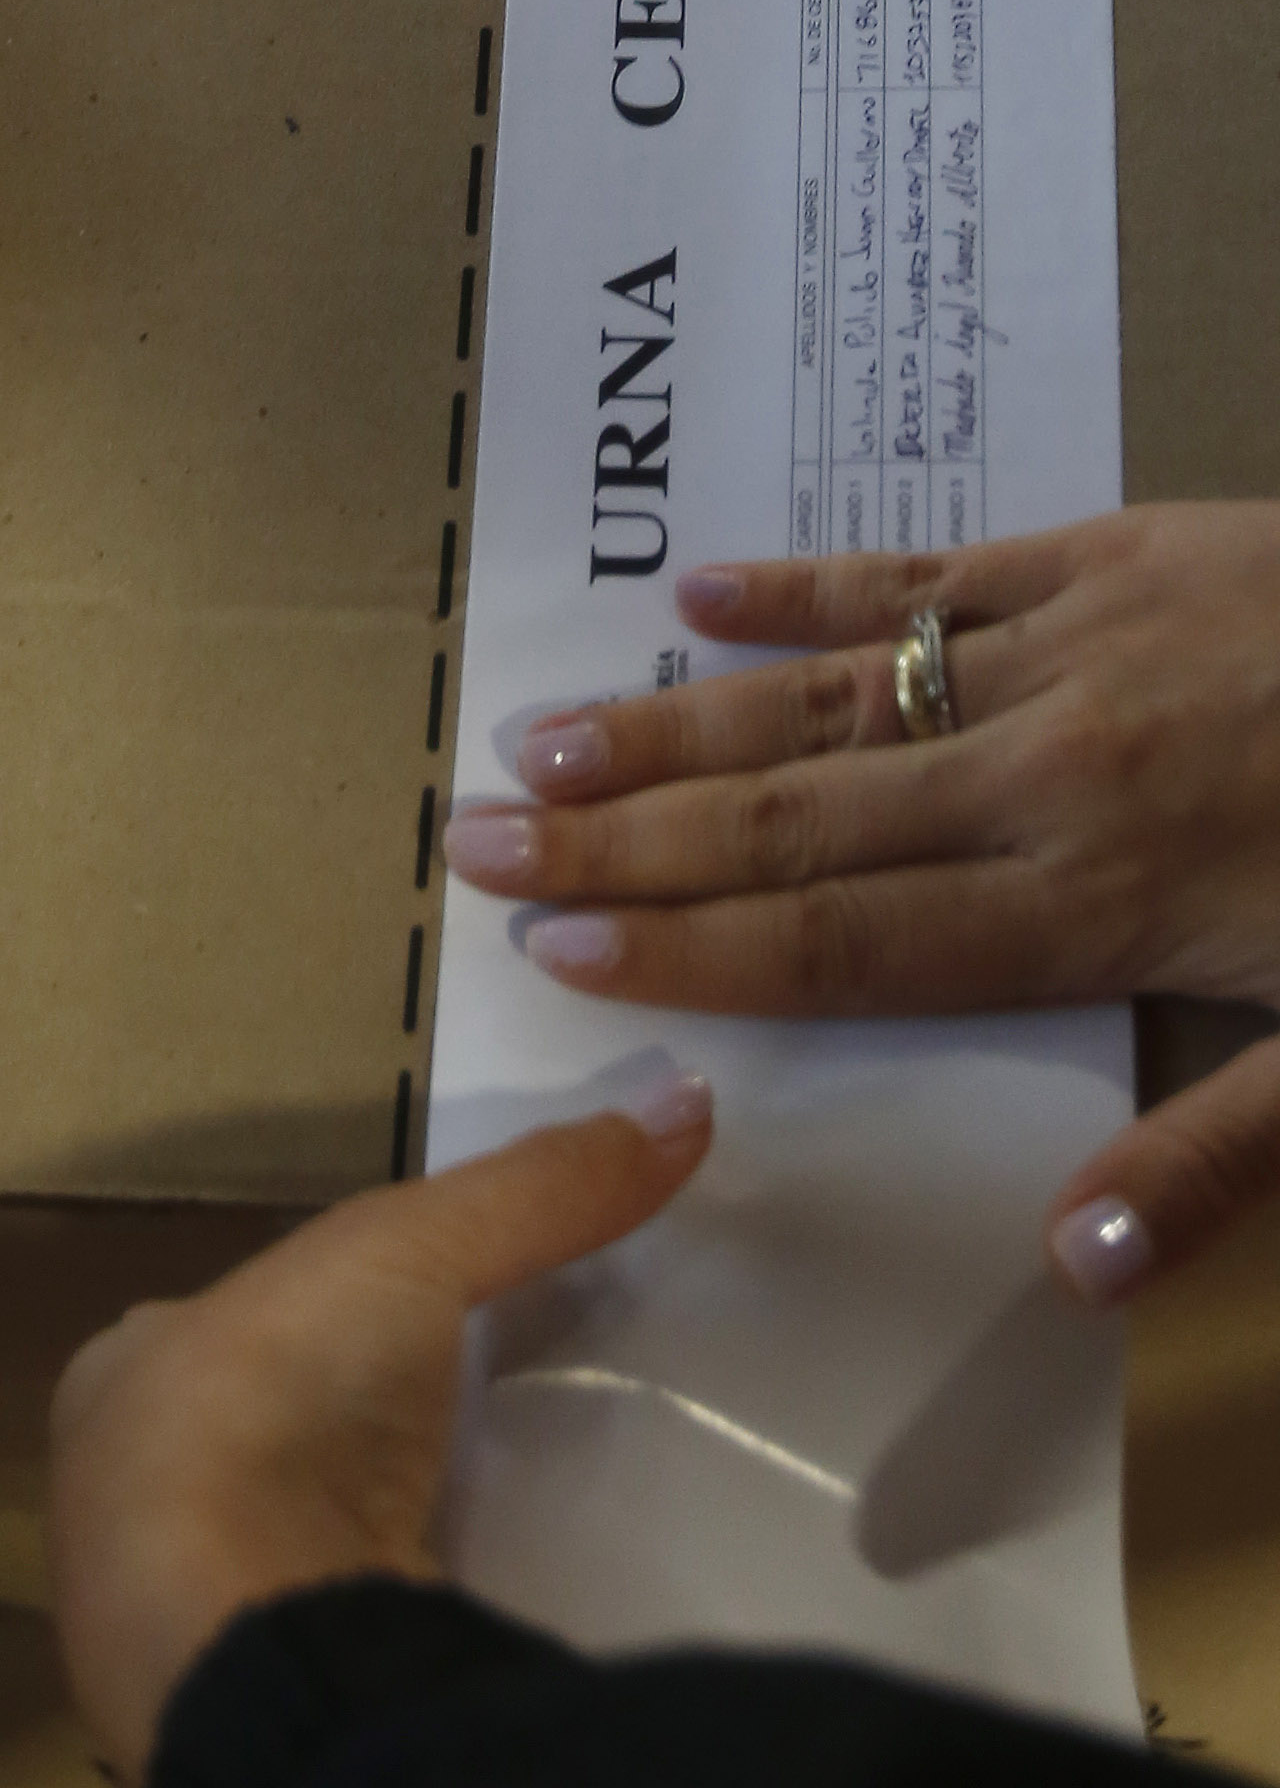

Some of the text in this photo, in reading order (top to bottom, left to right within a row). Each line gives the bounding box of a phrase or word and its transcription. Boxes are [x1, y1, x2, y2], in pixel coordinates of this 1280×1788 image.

[802, 177, 819, 256] NOMBRES
[801, 282, 818, 368] APELLIDOS
[588, 247, 677, 586] URNA
[846, 491, 862, 552] URADO
